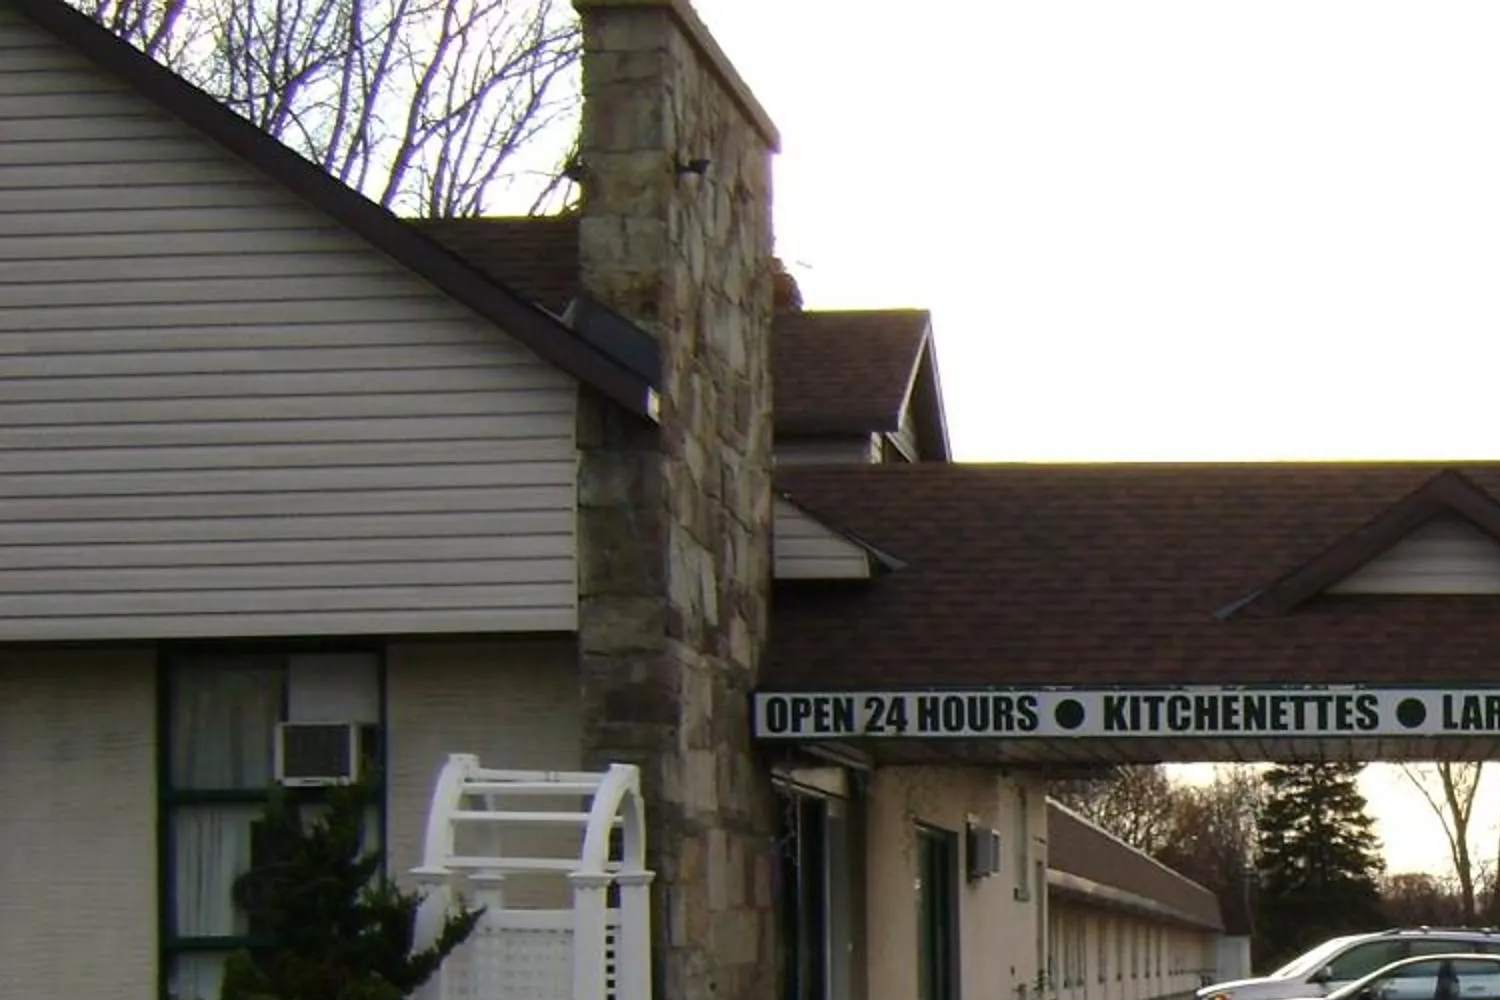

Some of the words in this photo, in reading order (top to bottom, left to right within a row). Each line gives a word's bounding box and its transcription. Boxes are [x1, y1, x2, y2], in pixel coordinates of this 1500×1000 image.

[765, 696, 854, 734] OPEN
[864, 696, 908, 733] 24
[917, 695, 1039, 733] HOURS
[1103, 695, 1380, 731] KITCHENETTES
